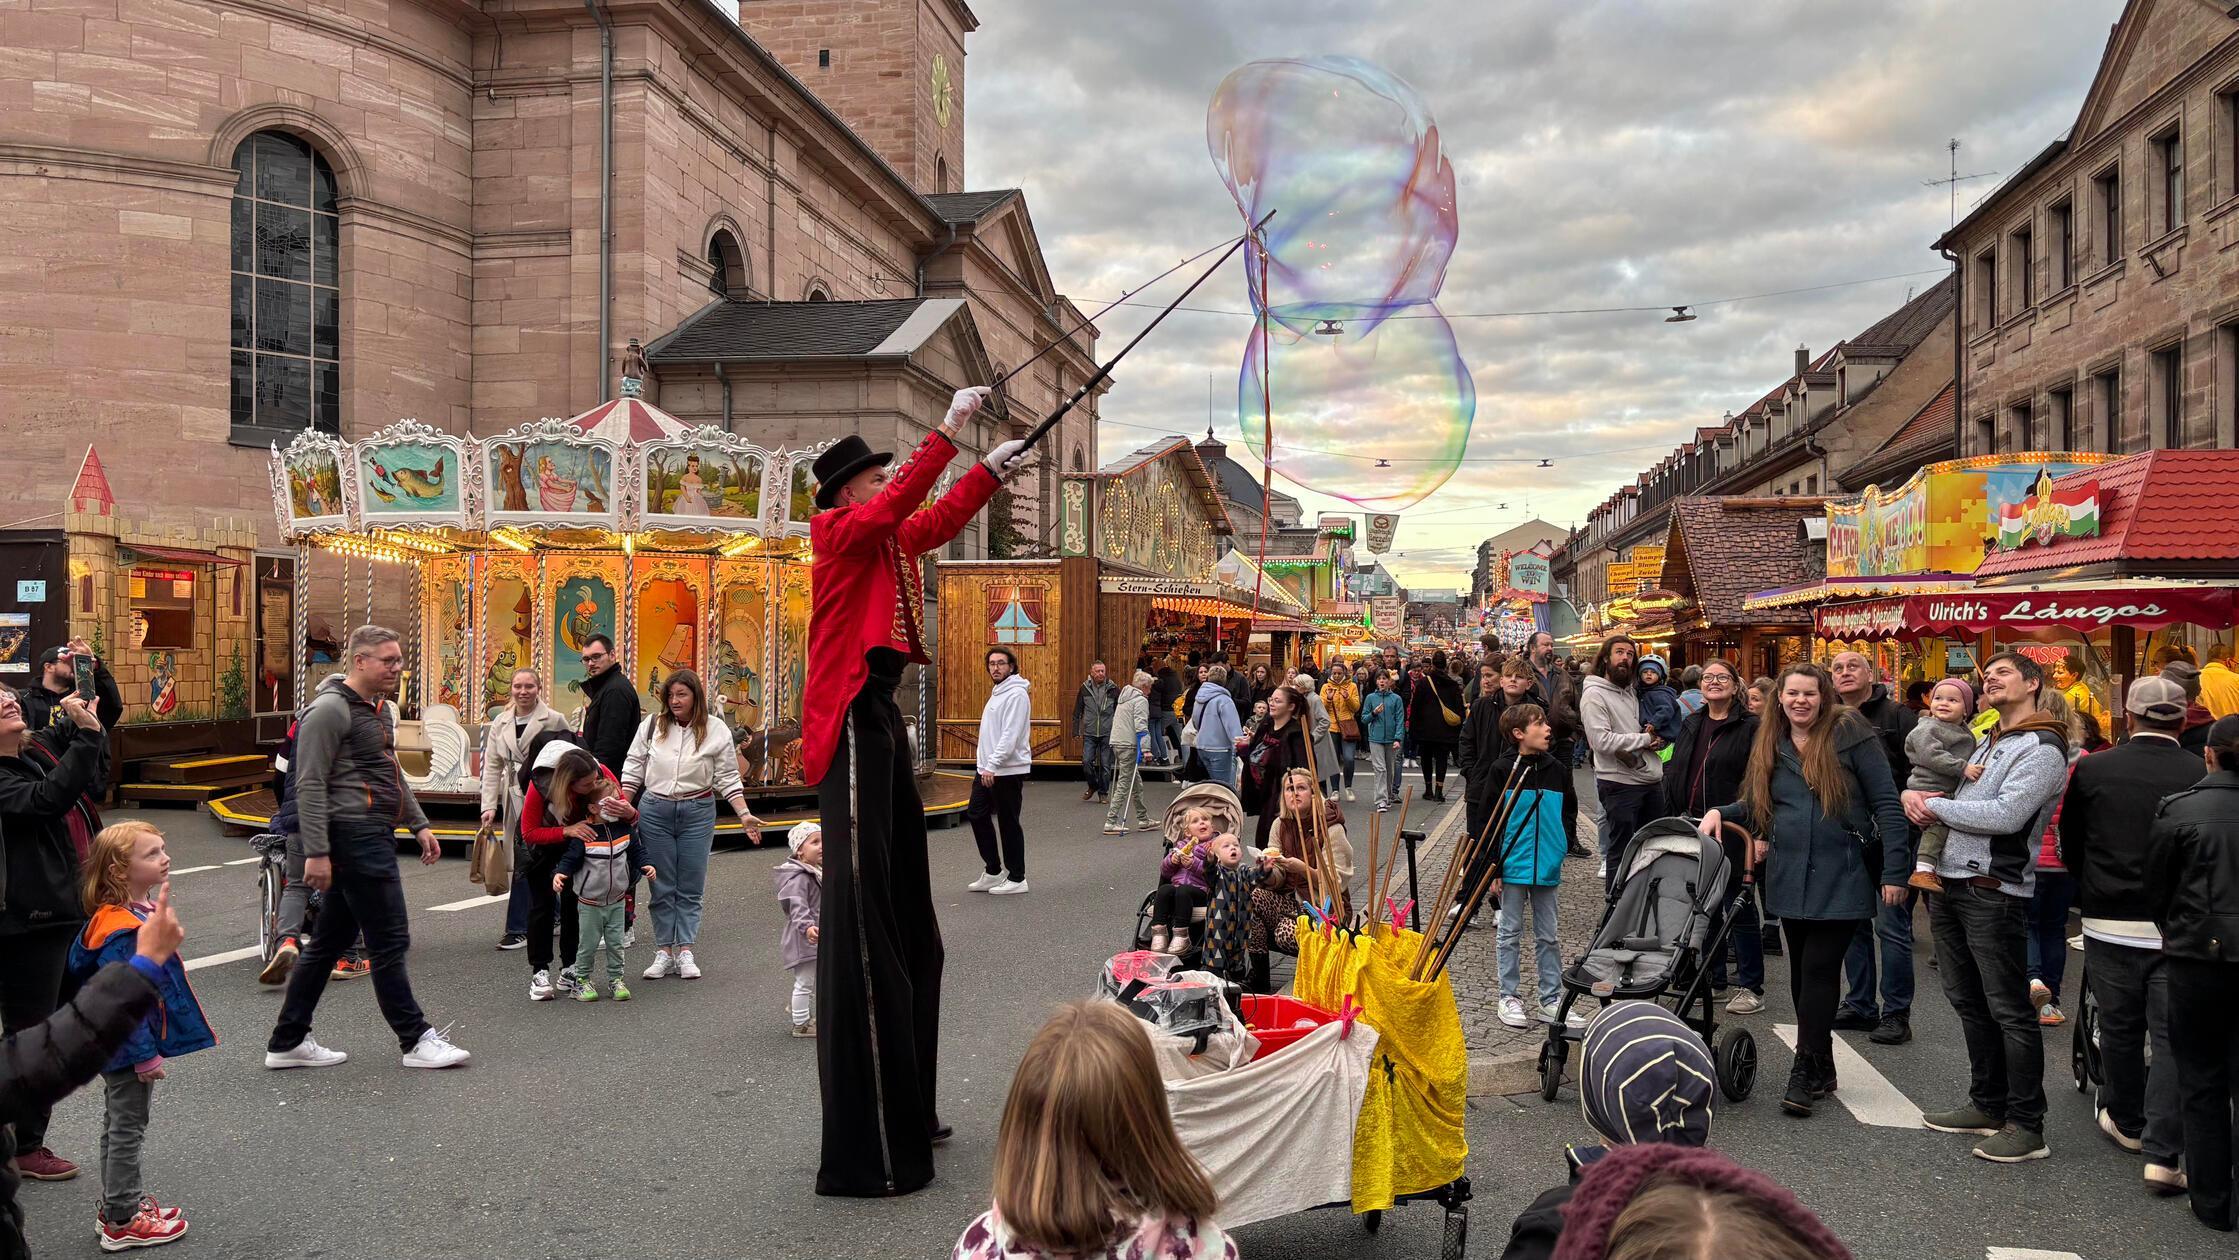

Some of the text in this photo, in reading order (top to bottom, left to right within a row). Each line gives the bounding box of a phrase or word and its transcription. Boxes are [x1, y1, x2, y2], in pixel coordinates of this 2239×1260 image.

[1829, 523, 1860, 562] CATCH
[1514, 563, 1548, 571] WELCOME
[1118, 582, 1201, 595] Stern-Schießen
[1521, 576, 1541, 585] WIN
[1929, 601, 1988, 621] Ulrich's
[2016, 646, 2070, 666] KASSA
